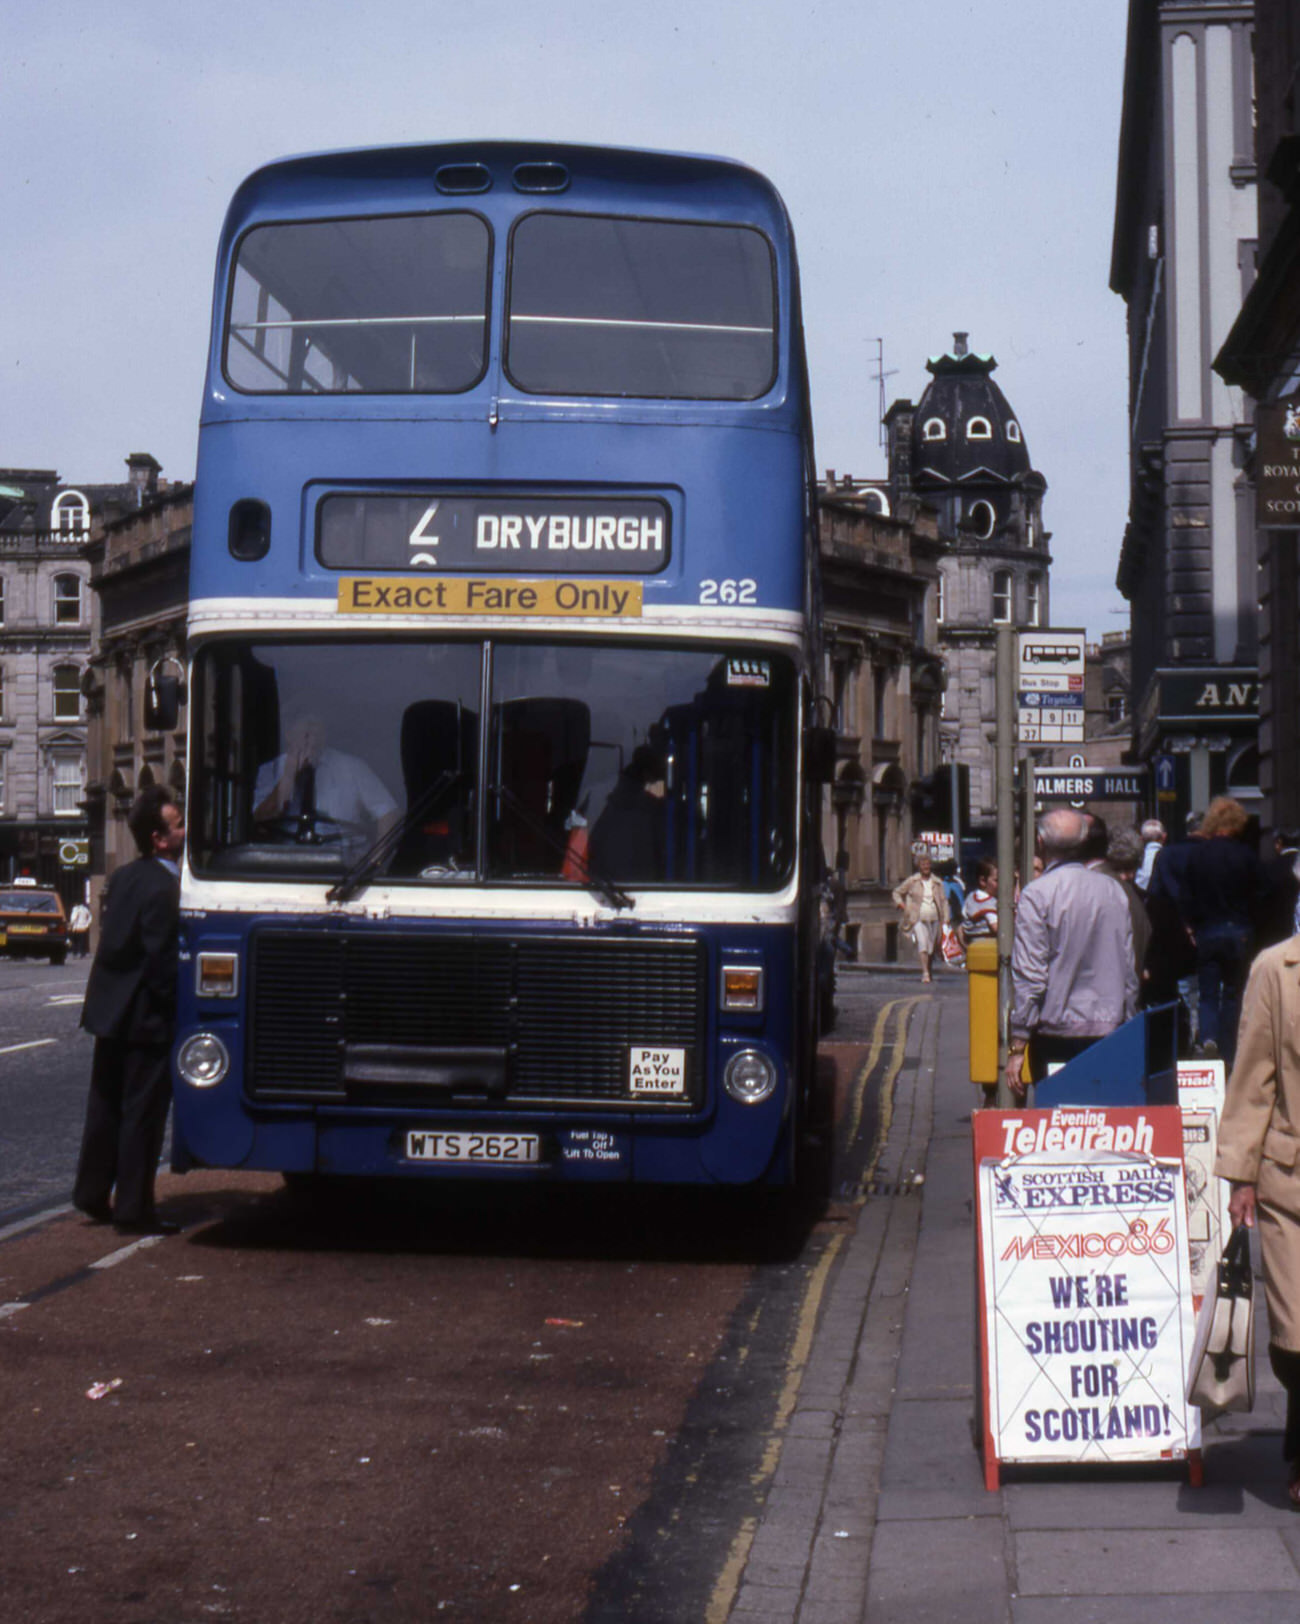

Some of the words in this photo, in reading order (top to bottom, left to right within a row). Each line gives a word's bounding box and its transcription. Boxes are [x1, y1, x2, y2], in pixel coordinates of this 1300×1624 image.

[476, 514, 663, 551] DRYBURGH
[352, 580, 447, 609] Exact
[467, 581, 537, 610] Fare
[556, 583, 629, 615] Only
[699, 578, 757, 605] 262
[1026, 712, 1033, 723] 2
[1049, 712, 1056, 724] 9
[1067, 712, 1077, 724] 11
[1024, 729, 1036, 740] 37
[1104, 778, 1141, 794] HALL
[641, 1050, 670, 1065] Pay
[632, 1064, 651, 1075] As
[653, 1064, 680, 1076] You
[634, 1077, 676, 1090] Enter
[1051, 1109, 1106, 1129] Evening
[410, 1133, 461, 1156] WTS
[467, 1136, 538, 1160] 262T
[1002, 1115, 1154, 1155] Telegraph
[1022, 1170, 1105, 1186] SCOTTISH
[1118, 1166, 1168, 1182] DAILY
[1024, 1180, 1175, 1209] EXPRESS
[1048, 1268, 1129, 1309] WE'RE
[1024, 1316, 1158, 1355] SHOUTING
[1070, 1362, 1120, 1399] FOR
[1024, 1403, 1172, 1443] SCOTLAND!
